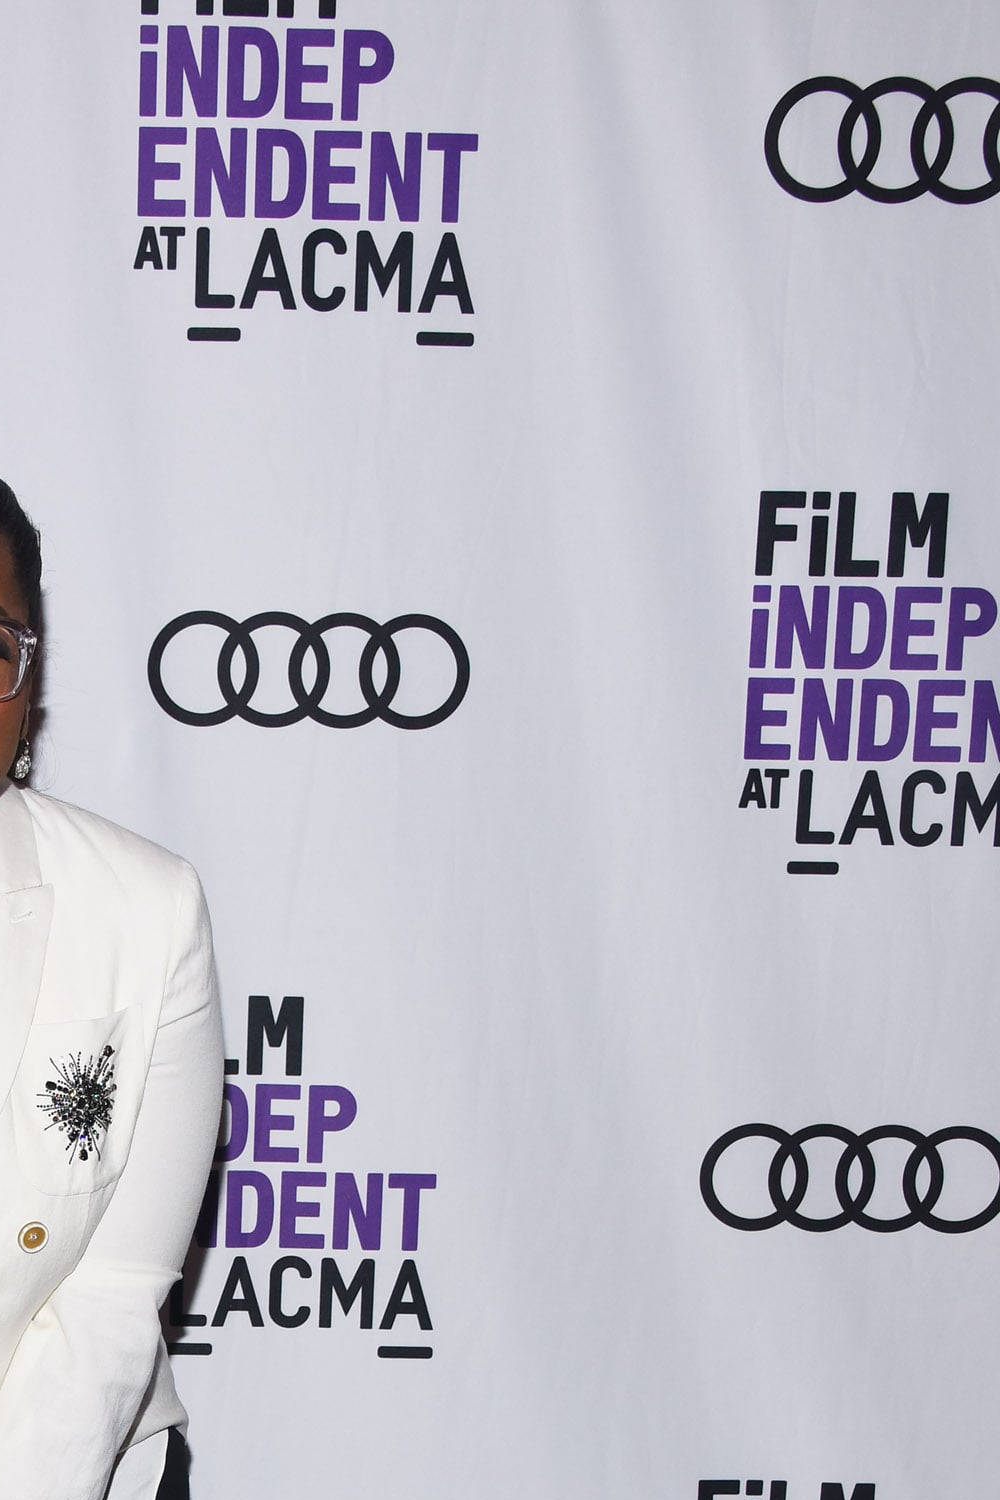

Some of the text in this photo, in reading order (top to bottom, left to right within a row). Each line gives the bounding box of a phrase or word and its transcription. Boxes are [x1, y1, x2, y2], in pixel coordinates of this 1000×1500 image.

[137, 127, 478, 223] ENDENT
[134, 226, 475, 314] AT LACMA
[738, 768, 1000, 847] AT LACM
[224, 995, 304, 1076] M
